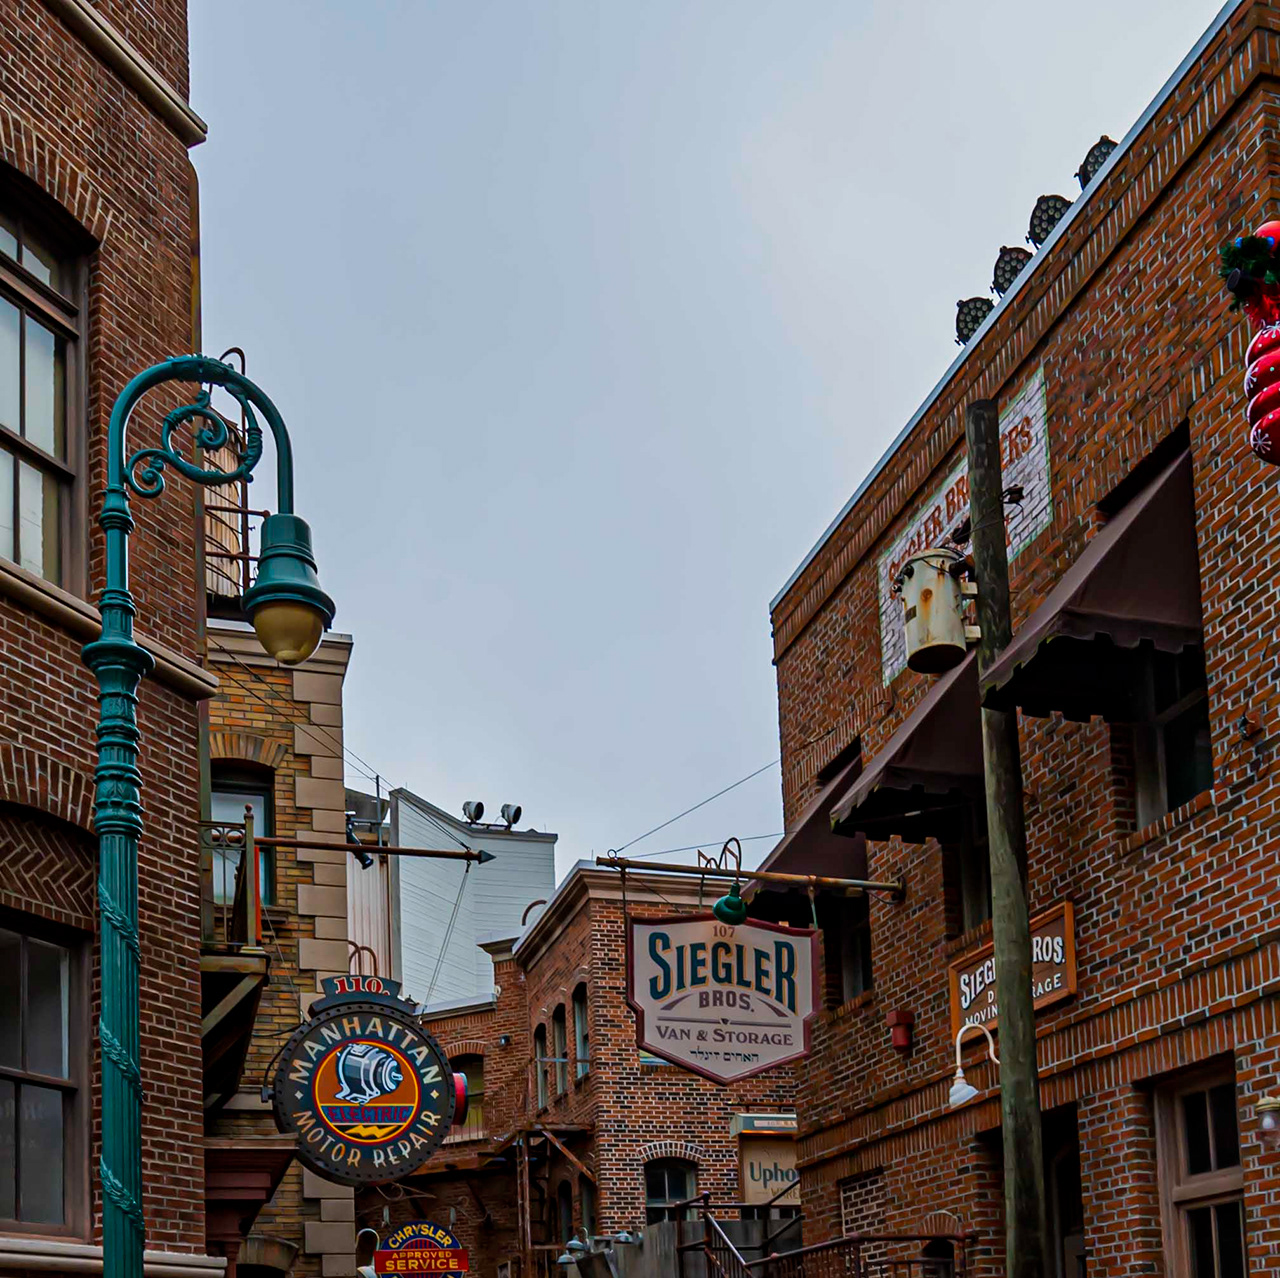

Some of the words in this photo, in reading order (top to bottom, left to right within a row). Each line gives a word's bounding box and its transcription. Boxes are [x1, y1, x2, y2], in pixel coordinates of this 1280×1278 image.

[712, 925, 736, 939] 107
[648, 932, 798, 1016] SIEGLER
[699, 990, 755, 1013] BROS.
[964, 1003, 999, 1027] MOVIN
[655, 1025, 691, 1041] VAN
[696, 1029, 709, 1042] &
[712, 1028, 794, 1046] STORAGE
[288, 1016, 443, 1085] MANHATTAN
[331, 1106, 414, 1123] ELECTRIC
[292, 1110, 362, 1168] MOTOR
[372, 1109, 442, 1168] REPAIR
[388, 1224, 453, 1249] CHRYSLER
[385, 1259, 459, 1271] SERVICE
[392, 1250, 452, 1259] APPROVED
